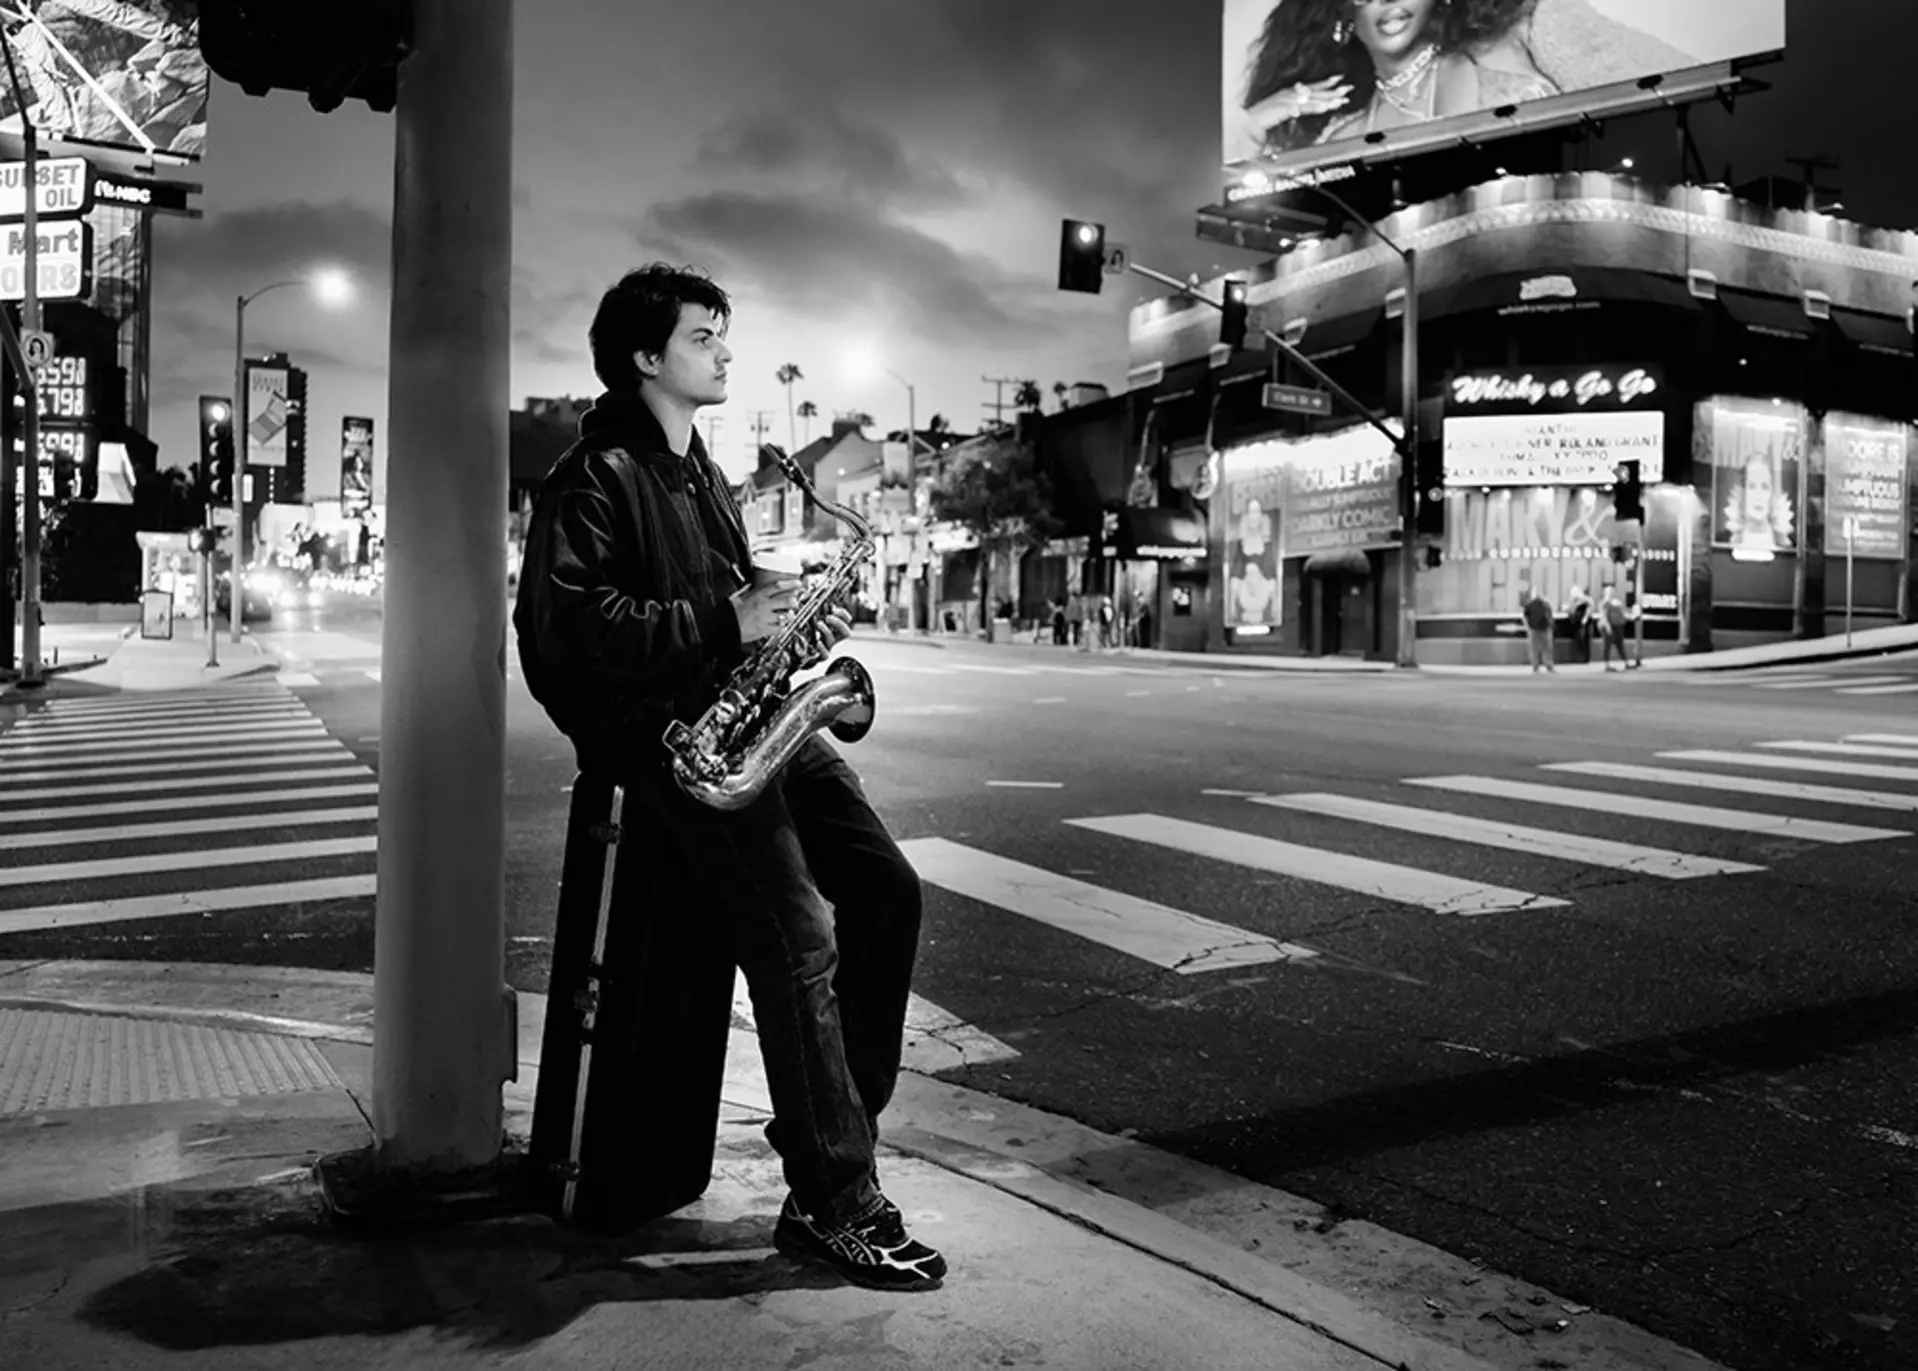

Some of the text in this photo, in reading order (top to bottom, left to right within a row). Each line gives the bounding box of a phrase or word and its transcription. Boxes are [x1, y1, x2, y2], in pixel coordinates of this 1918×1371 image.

[0, 164, 80, 189] USET
[45, 187, 78, 208] OIL
[1451, 368, 1657, 406] Whisky a Go Go
[1358, 458, 1392, 483] ACT
